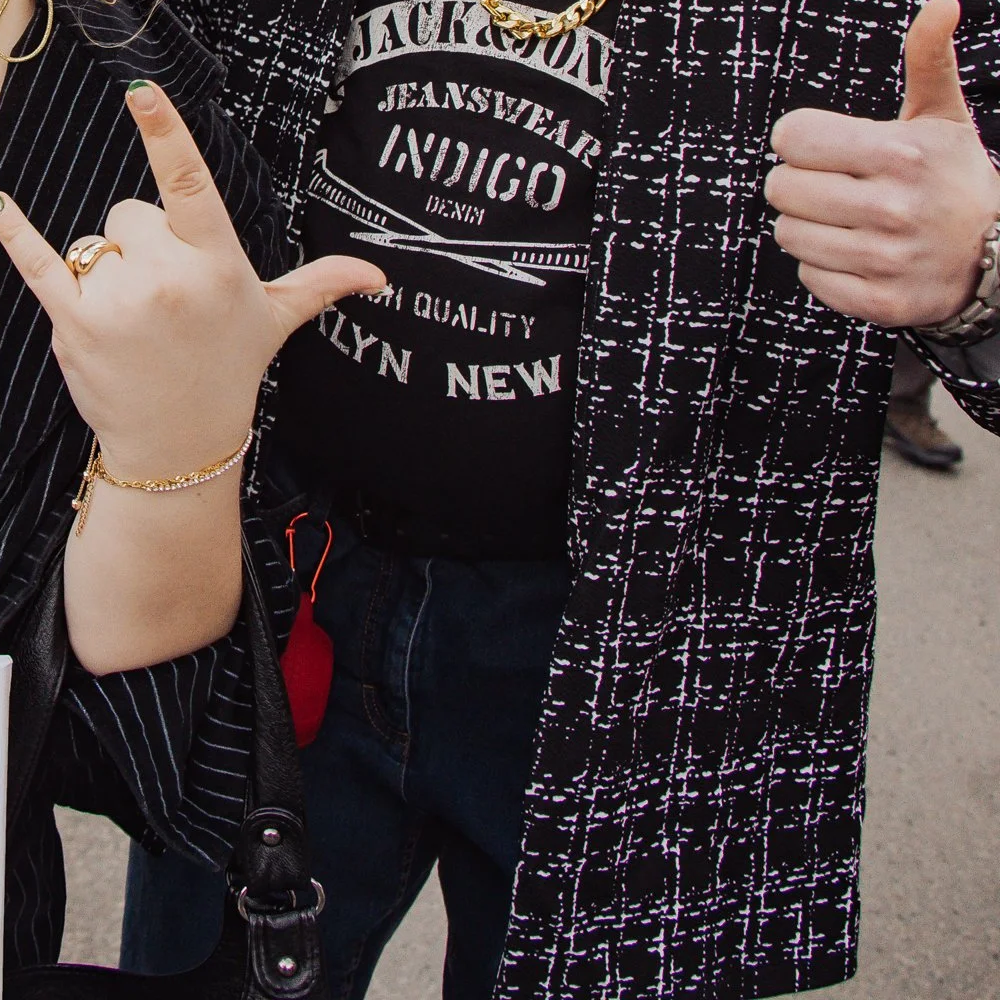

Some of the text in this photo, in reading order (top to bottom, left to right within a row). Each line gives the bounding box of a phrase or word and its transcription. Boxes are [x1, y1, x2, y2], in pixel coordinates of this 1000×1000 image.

[377, 81, 602, 169] JEANSWEAR
[379, 124, 566, 212] INDIGO
[425, 195, 485, 225] DENIM
[414, 291, 536, 339] QUALITY
[446, 355, 562, 400] NEW
